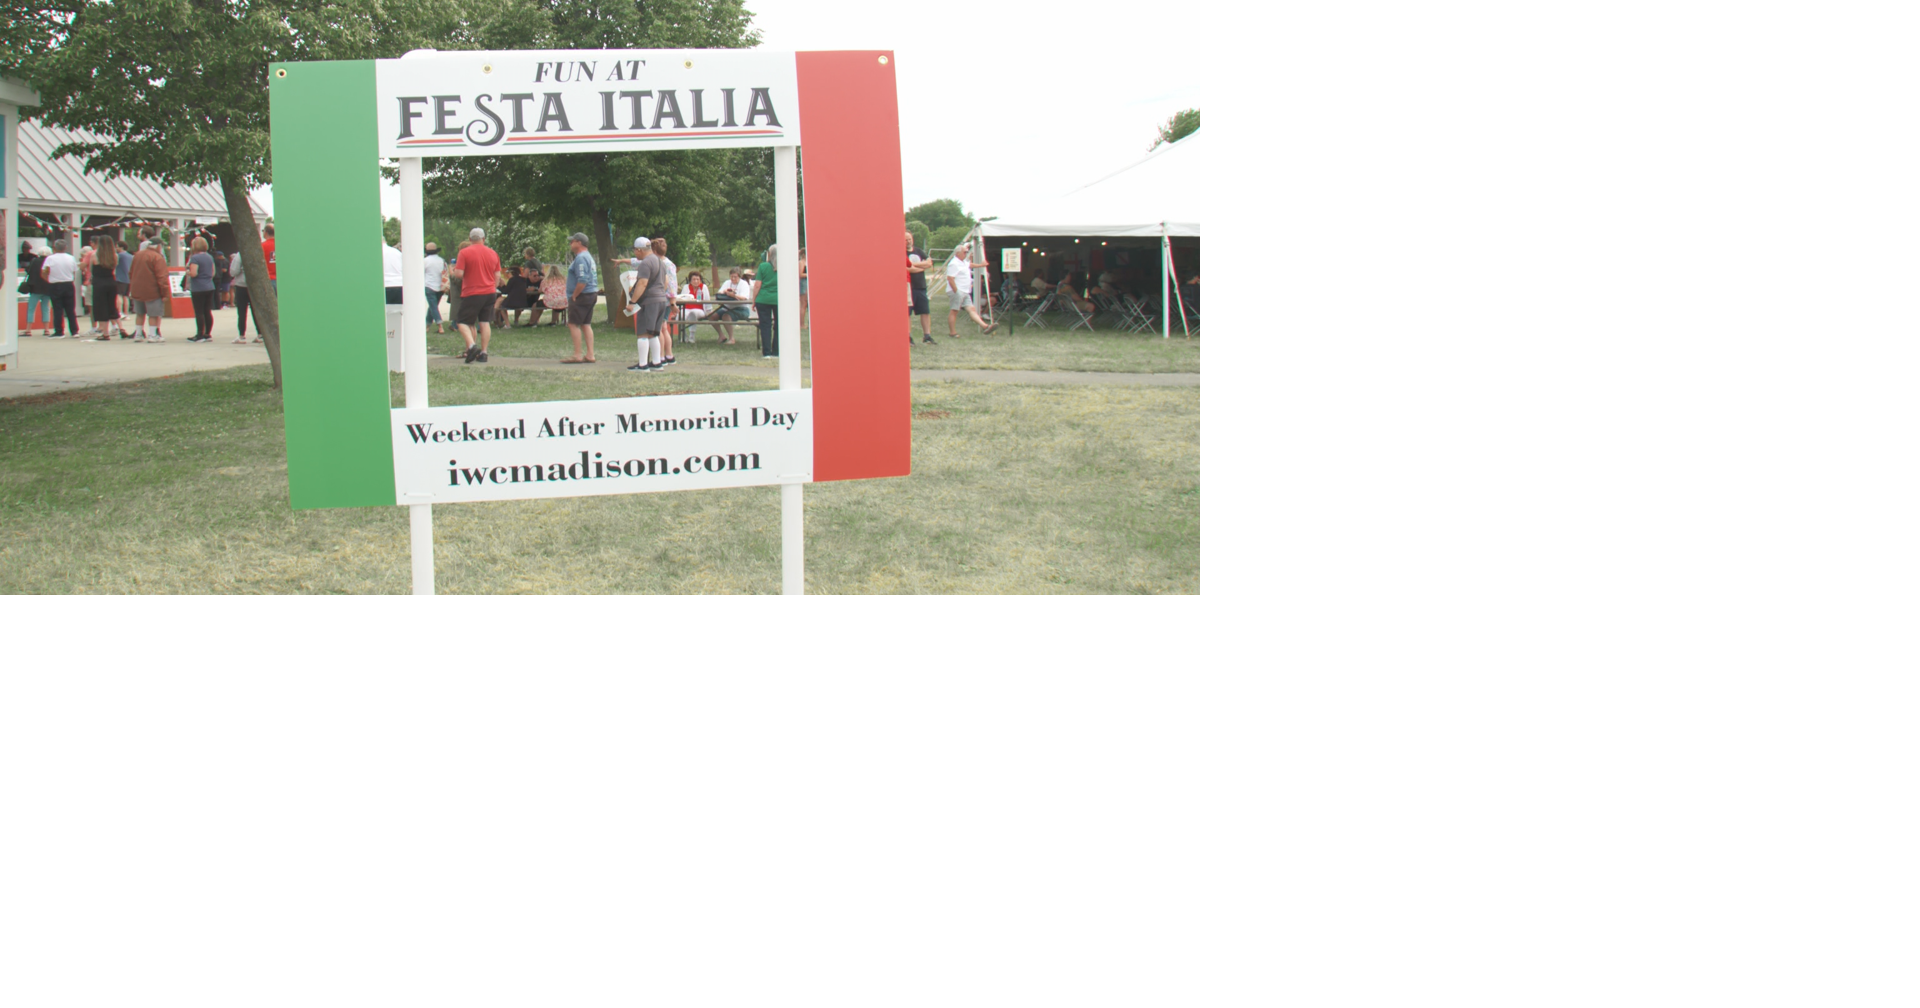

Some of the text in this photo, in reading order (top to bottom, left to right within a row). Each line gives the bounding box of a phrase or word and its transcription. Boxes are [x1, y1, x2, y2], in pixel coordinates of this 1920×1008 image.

[533, 59, 646, 83] FUN AT
[396, 87, 784, 147] FESTA ITALIA
[405, 406, 800, 444] Weekend After Memorial Day
[447, 450, 763, 487] iwcmadison.com
